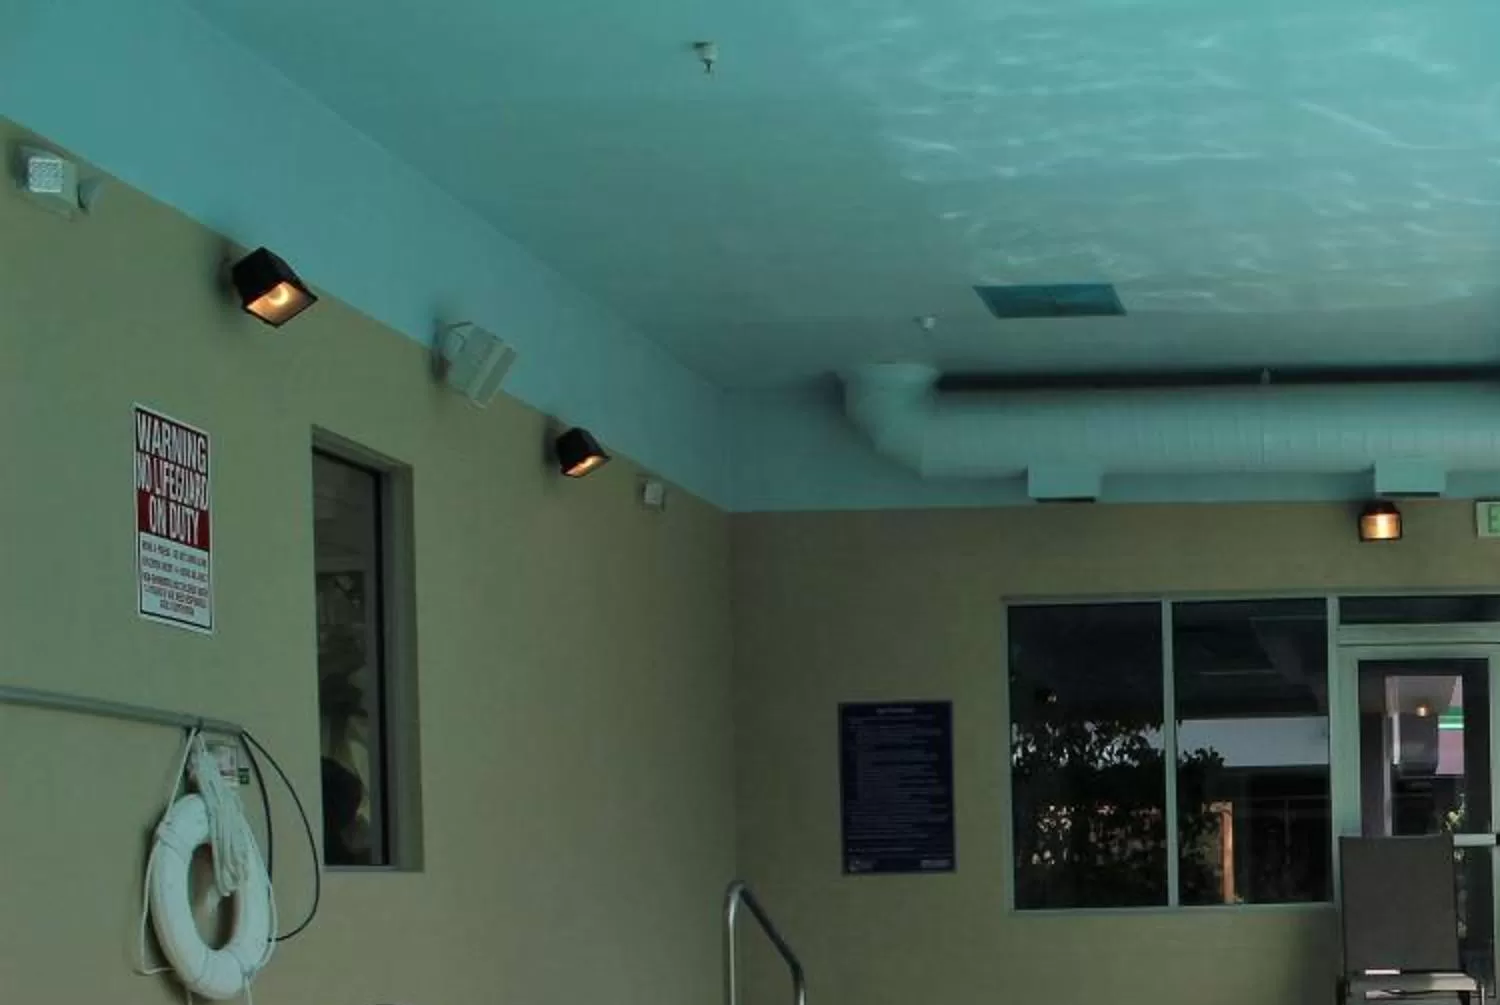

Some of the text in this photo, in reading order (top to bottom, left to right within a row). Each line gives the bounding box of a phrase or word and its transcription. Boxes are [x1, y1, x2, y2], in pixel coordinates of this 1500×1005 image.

[136, 411, 207, 474] WARNING
[136, 451, 209, 511] NO LIFEGUARD
[149, 494, 199, 545] ON DUTY
